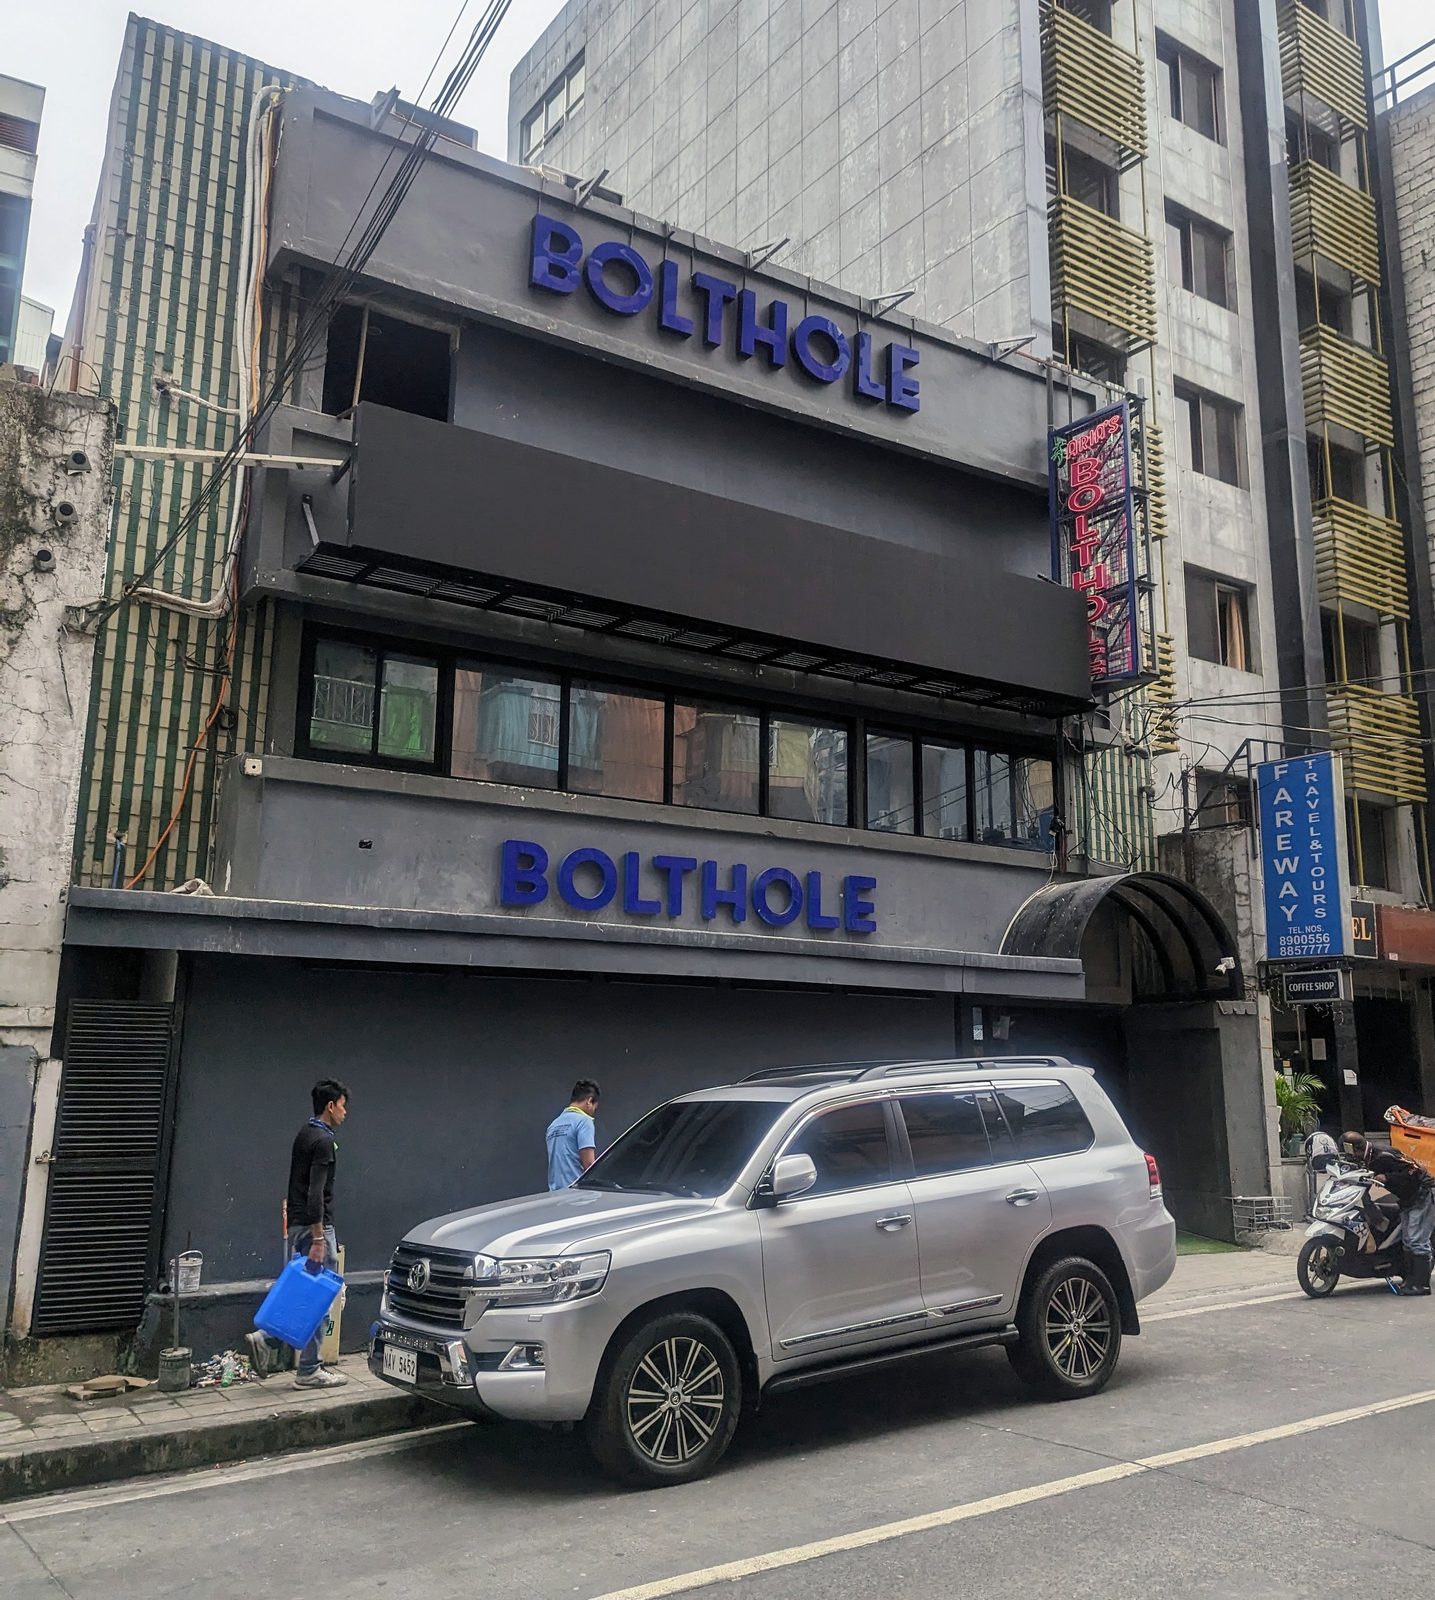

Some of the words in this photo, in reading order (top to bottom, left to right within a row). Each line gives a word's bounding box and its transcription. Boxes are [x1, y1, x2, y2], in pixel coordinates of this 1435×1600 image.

[529, 213, 920, 413] BOLTHOLE
[1066, 414, 1121, 458] ARIA'S
[1273, 764, 1299, 922] FAREWAY
[500, 839, 877, 933] BOLTHOLE
[1279, 933, 1330, 945] 8900556
[1305, 925, 1324, 933] NOS.
[1279, 944, 1330, 956] 8857777
[1288, 982, 1314, 992] COFFEE
[1315, 980, 1335, 991] SHOP
[384, 1353, 396, 1371] NAY
[398, 1356, 416, 1377] 5452
